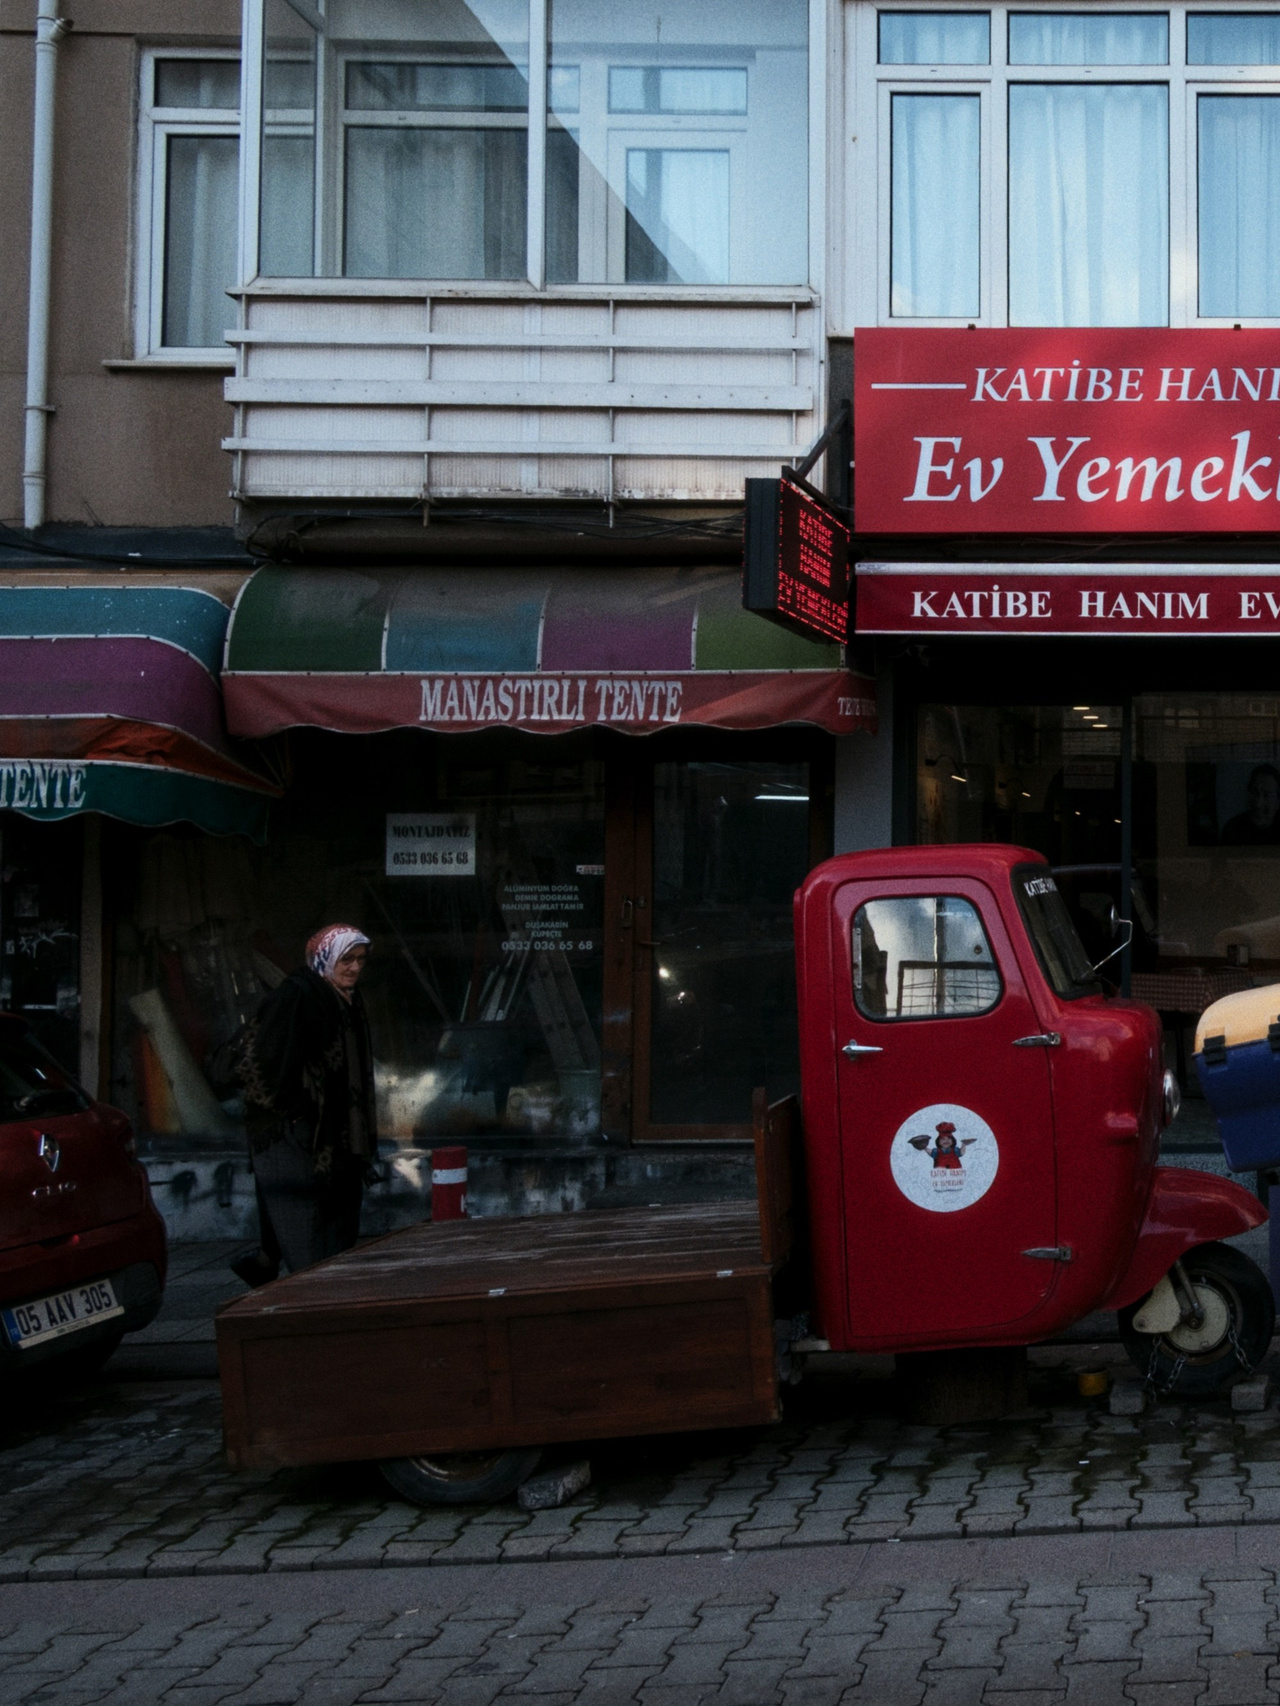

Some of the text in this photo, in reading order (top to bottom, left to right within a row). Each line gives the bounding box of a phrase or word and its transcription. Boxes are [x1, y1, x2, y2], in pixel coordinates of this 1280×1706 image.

[971, 359, 1144, 402] KATİBE
[902, 436, 1005, 503] Ev
[911, 584, 1052, 619] KATİBE
[1079, 590, 1210, 620] HANIM
[419, 679, 683, 722] MANASTIRLI TENTE
[393, 851, 469, 865] 0533 036 65 68
[501, 940, 593, 951] 0533 036 65 68
[16, 1304, 42, 1335] 05
[44, 1293, 77, 1326] AAV
[80, 1282, 112, 1314] 305
